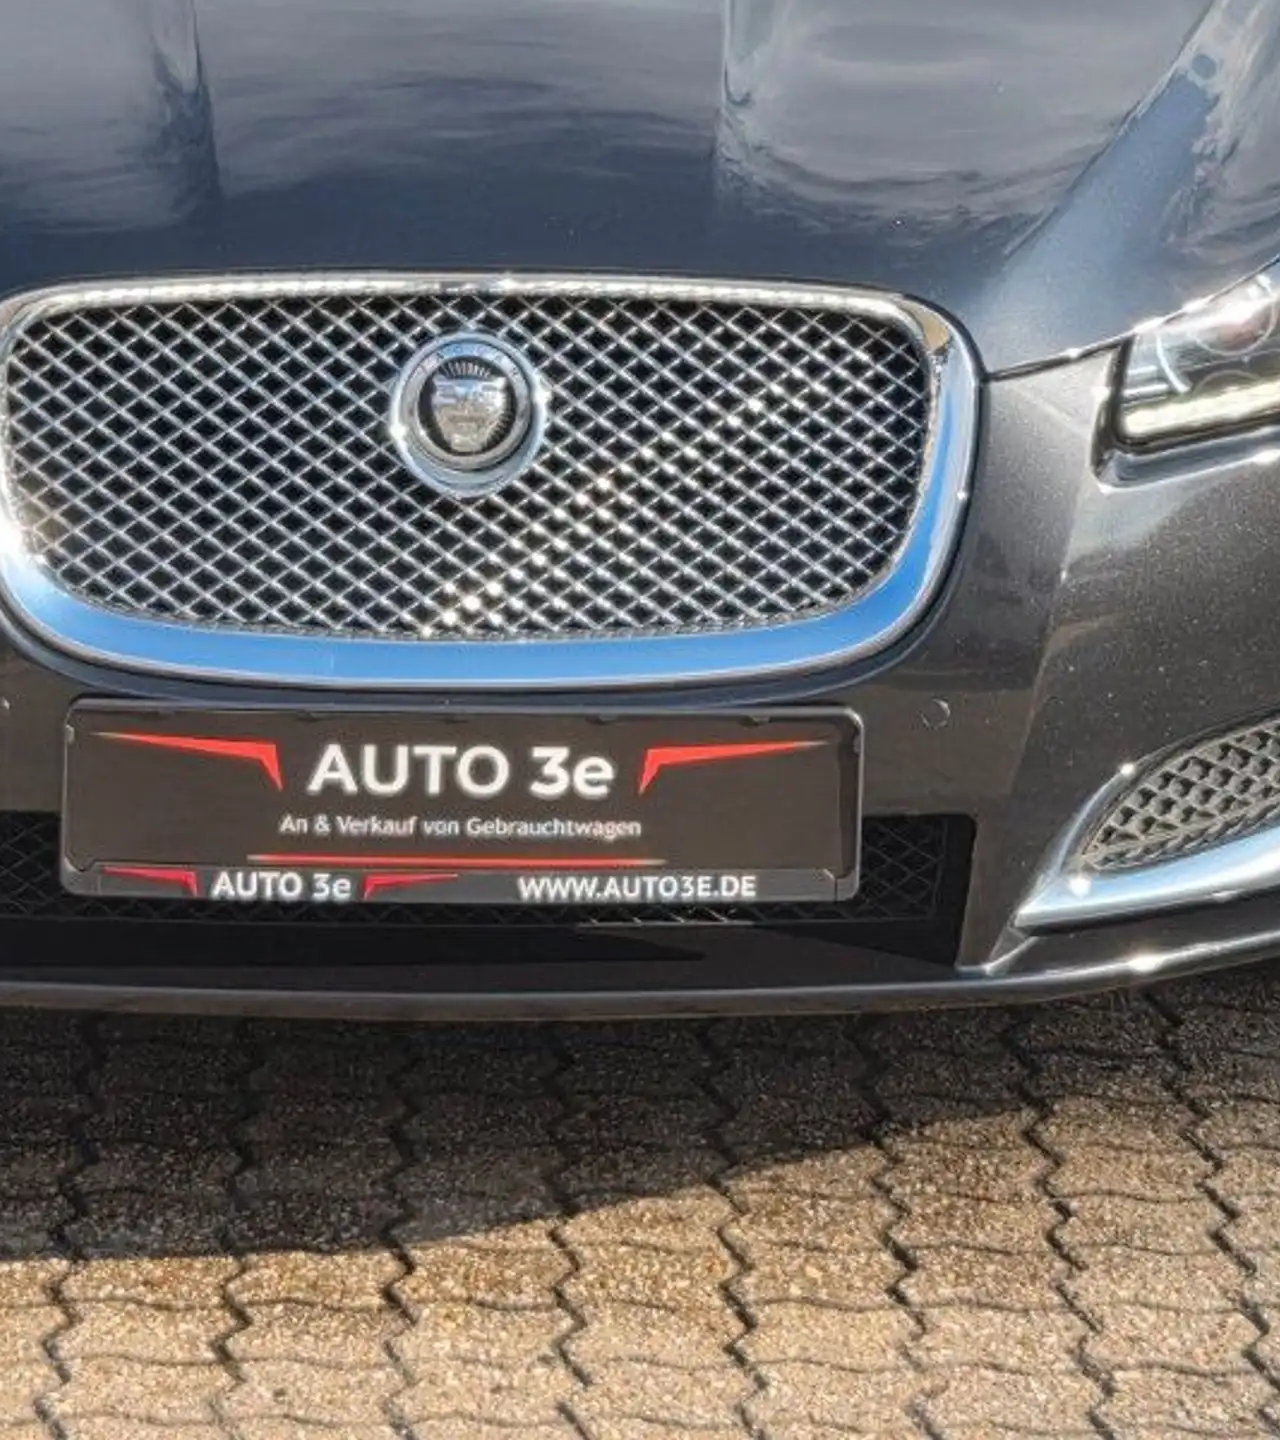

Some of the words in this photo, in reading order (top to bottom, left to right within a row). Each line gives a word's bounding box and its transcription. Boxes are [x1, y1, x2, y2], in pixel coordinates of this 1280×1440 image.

[307, 743, 510, 797] AUTO
[529, 745, 616, 799] 3e
[279, 814, 308, 834] An
[318, 814, 331, 834] &
[335, 814, 417, 836] Verkauf
[424, 820, 460, 836] von
[466, 817, 642, 841] Gebrauchtwagen
[212, 873, 303, 899] AUTO
[312, 873, 352, 900] 3e
[518, 875, 757, 901] WWW.AUTO3E.DE
